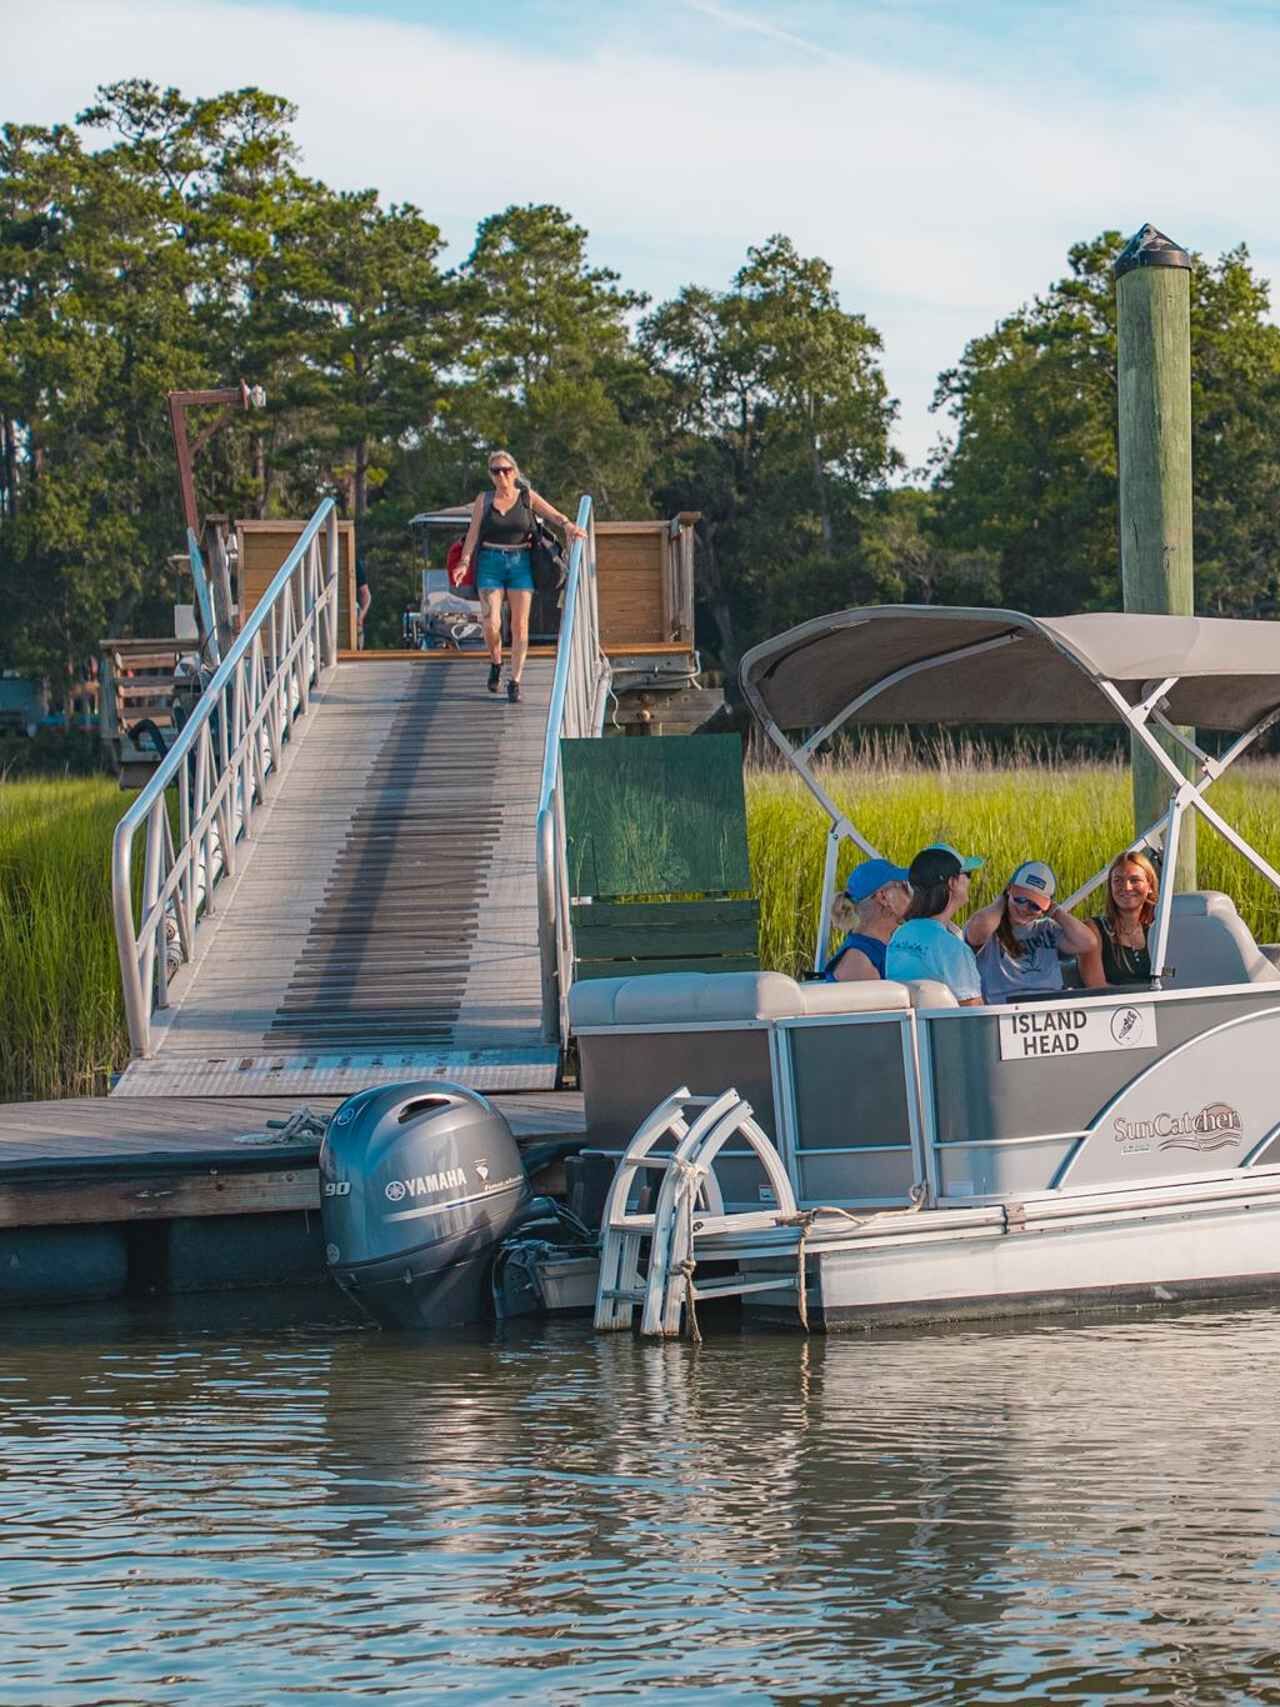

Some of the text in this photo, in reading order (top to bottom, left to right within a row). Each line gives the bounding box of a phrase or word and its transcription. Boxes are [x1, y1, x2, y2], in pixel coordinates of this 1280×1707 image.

[1012, 1010, 1087, 1034] ISLAND
[1023, 1033, 1079, 1055] HEAD
[1113, 1108, 1241, 1142] SunCatcher
[324, 1182, 350, 1197] 90
[405, 1167, 468, 1197] YAMAHA
